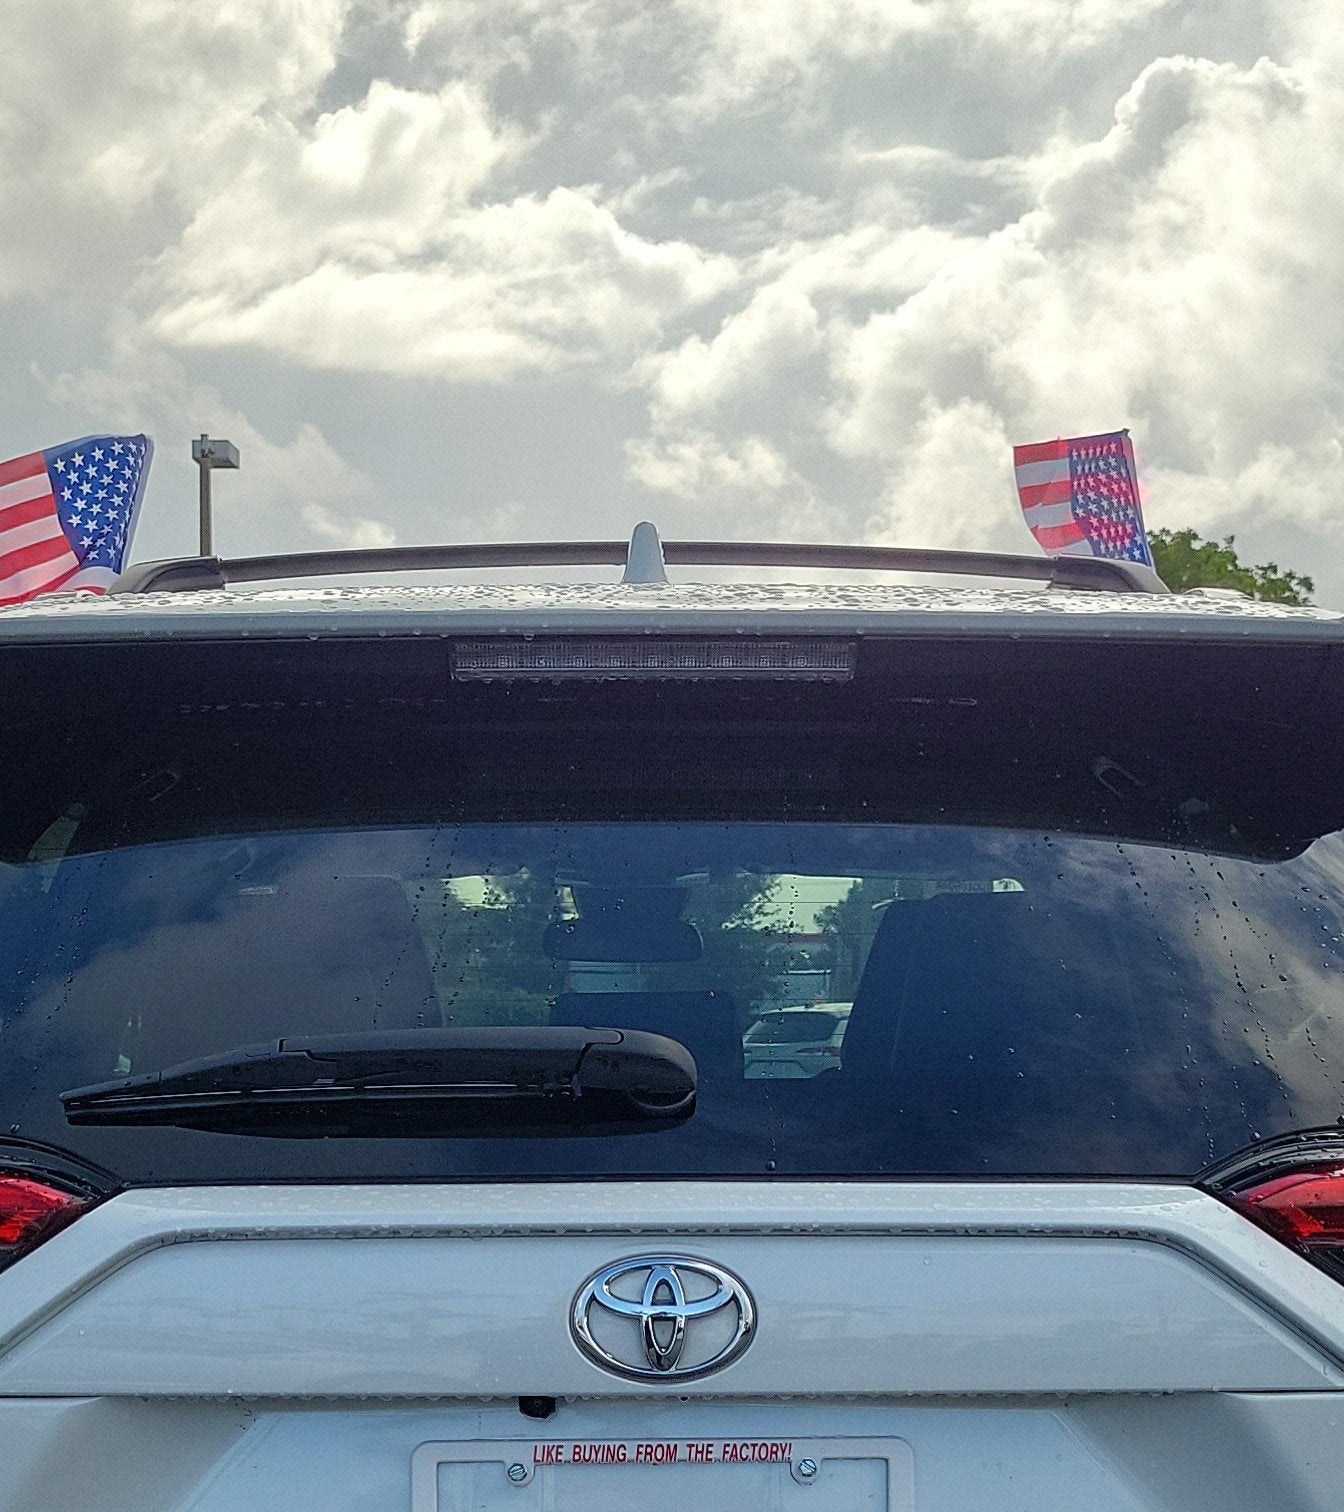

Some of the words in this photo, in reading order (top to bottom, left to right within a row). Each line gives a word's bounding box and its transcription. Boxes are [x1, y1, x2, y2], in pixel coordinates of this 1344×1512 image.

[534, 1444, 565, 1464] LIKE
[572, 1444, 627, 1463] BUYING
[635, 1443, 678, 1463] FROM
[686, 1443, 714, 1462] THE
[722, 1442, 793, 1462] FACTORY!
